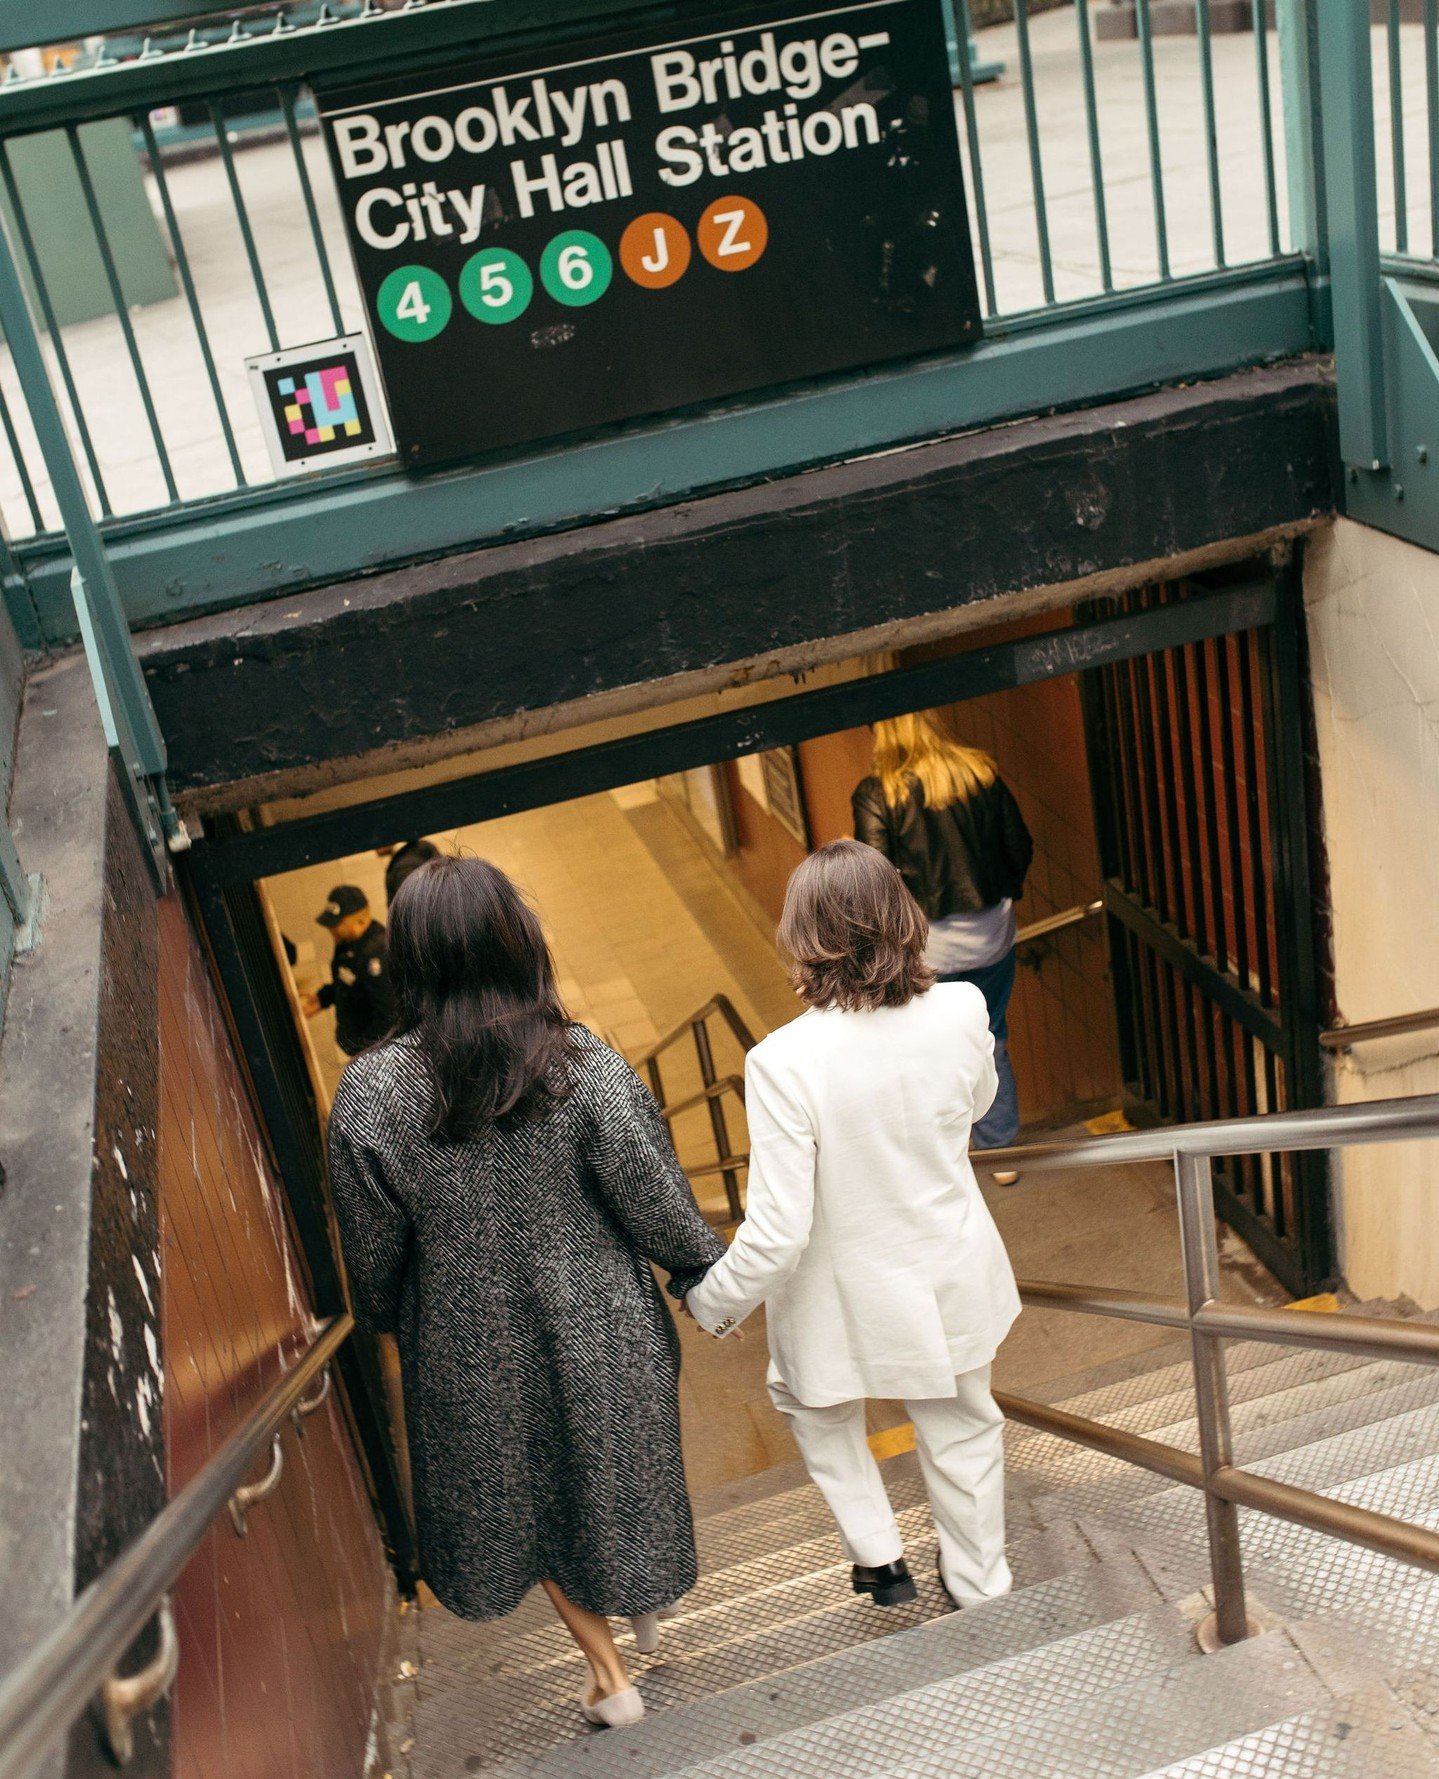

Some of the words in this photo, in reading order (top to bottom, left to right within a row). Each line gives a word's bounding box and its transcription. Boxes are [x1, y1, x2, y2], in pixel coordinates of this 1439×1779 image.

[333, 78, 631, 179] Brooklyn
[651, 32, 889, 113] Bridge-
[355, 182, 485, 249] City
[510, 139, 632, 218] Hall
[655, 102, 880, 187] Station
[396, 281, 431, 324] 4
[480, 261, 514, 308] 5
[557, 245, 593, 290] 6
[641, 227, 669, 273] J
[713, 209, 751, 257] Z
